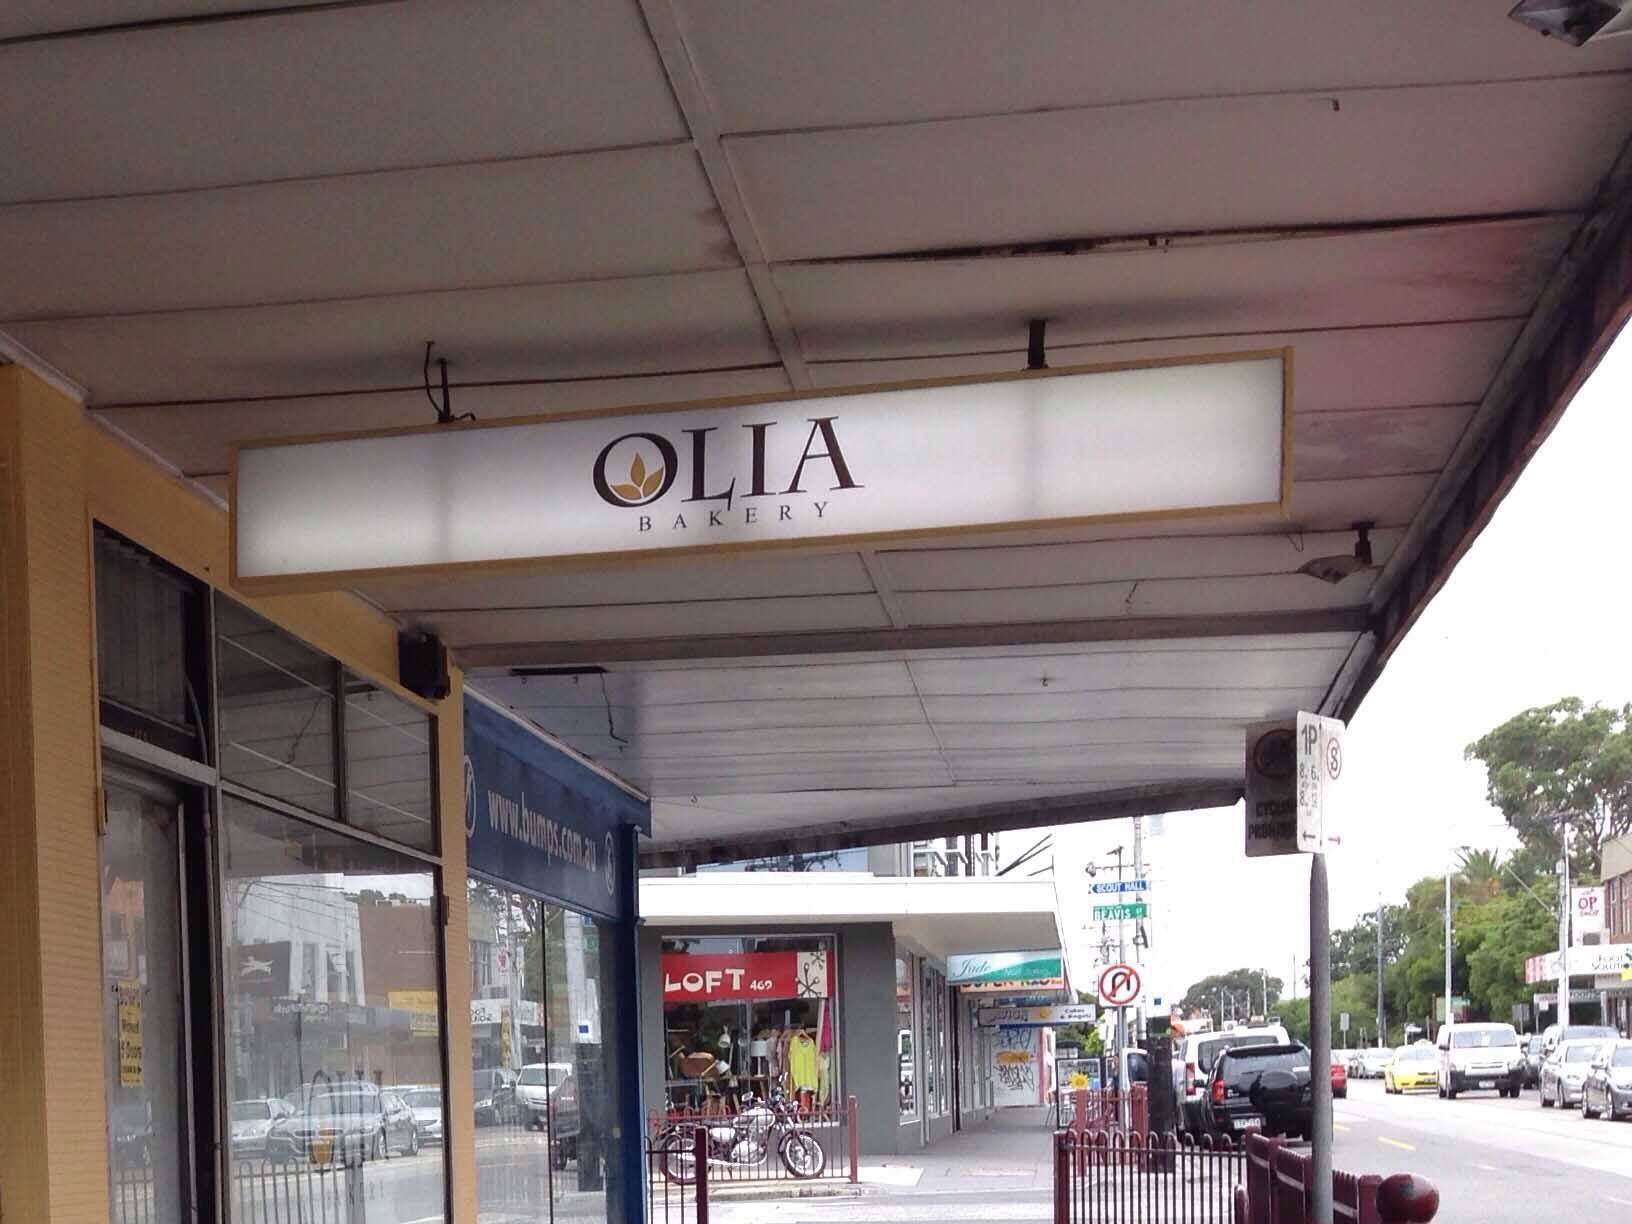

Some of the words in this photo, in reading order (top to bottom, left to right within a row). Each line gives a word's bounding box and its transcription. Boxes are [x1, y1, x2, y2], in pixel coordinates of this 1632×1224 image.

[592, 415, 865, 511] OLIA
[638, 501, 830, 532] BAKERY
[1301, 722, 1318, 756] 1P
[487, 788, 597, 873] www.bumps.com.au
[1096, 883, 1121, 893] SCOUT
[1124, 881, 1145, 891] HALL
[1094, 908, 1131, 920] BEAVIS
[1578, 896, 1597, 909] OP
[664, 968, 745, 993] LOFT
